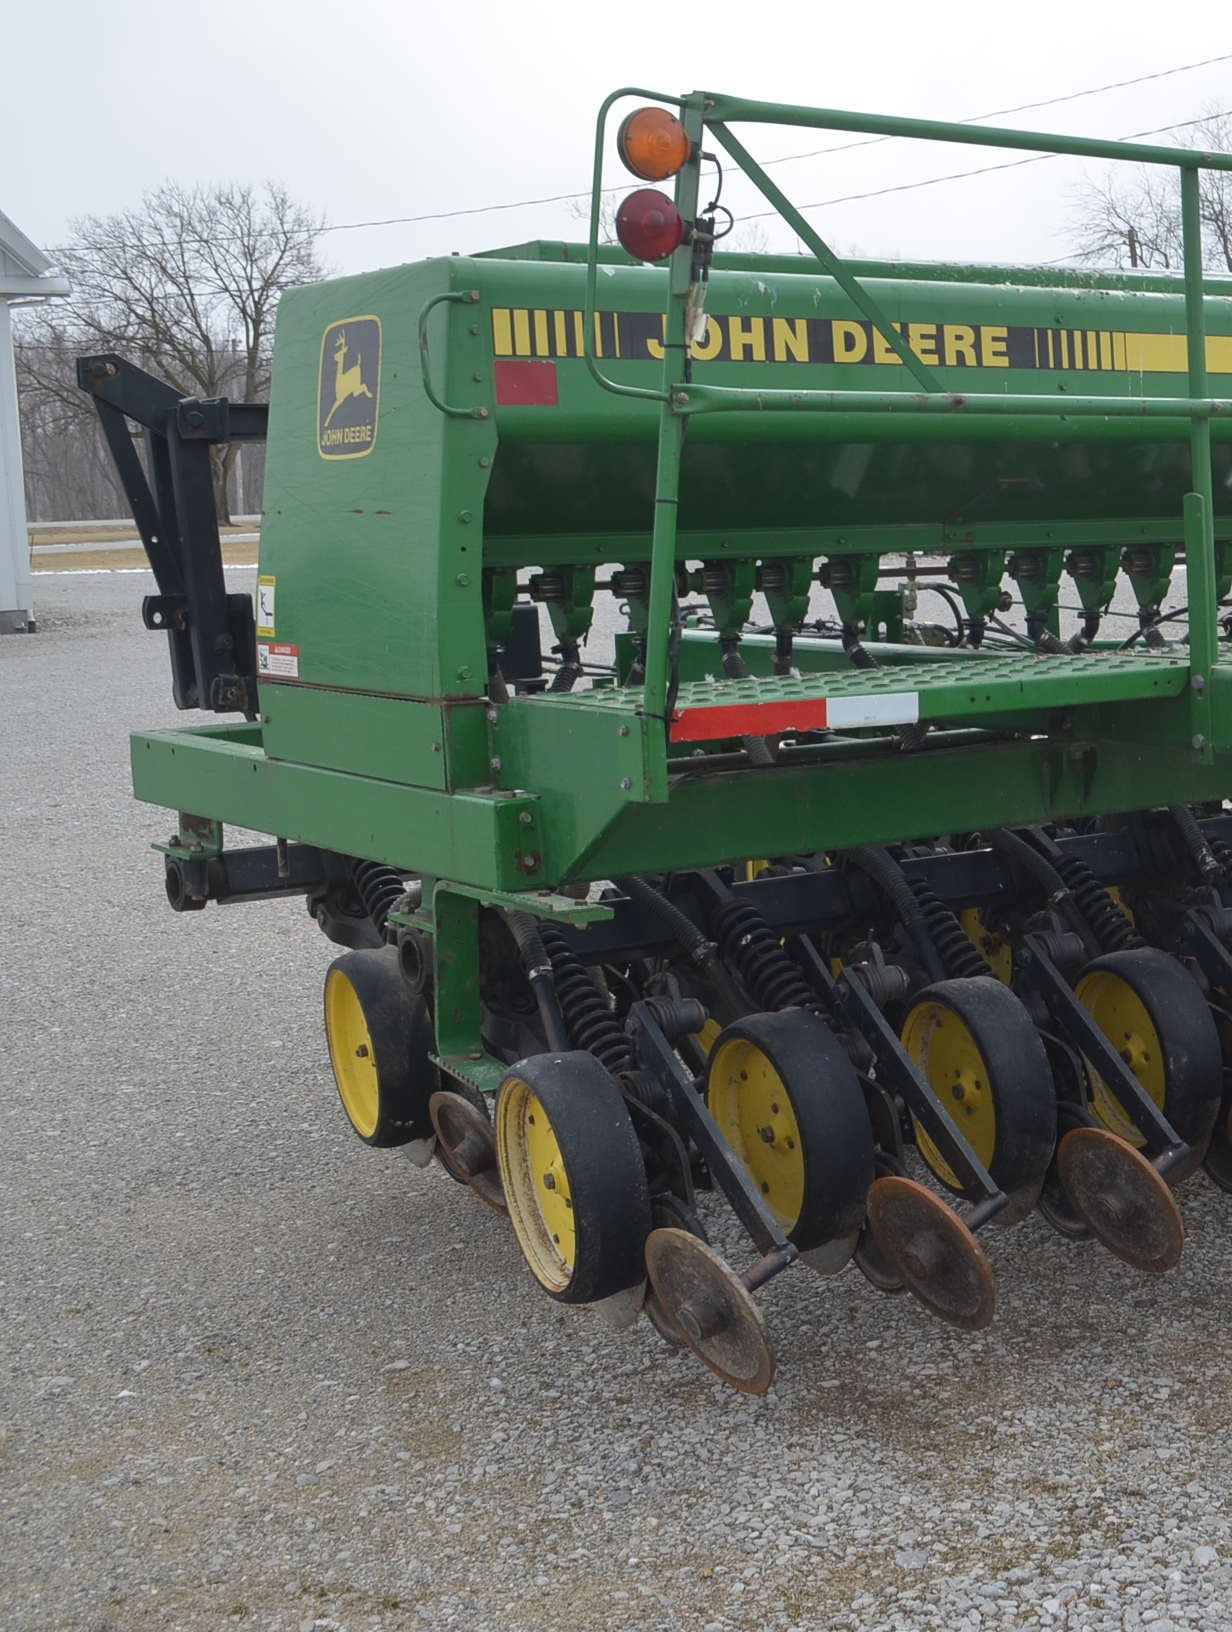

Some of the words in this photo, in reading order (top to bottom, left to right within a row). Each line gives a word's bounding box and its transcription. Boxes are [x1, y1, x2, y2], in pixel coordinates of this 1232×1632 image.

[831, 320, 1010, 367] DEERE
[321, 428, 343, 446] JOHN
[344, 425, 372, 443] DEERE
